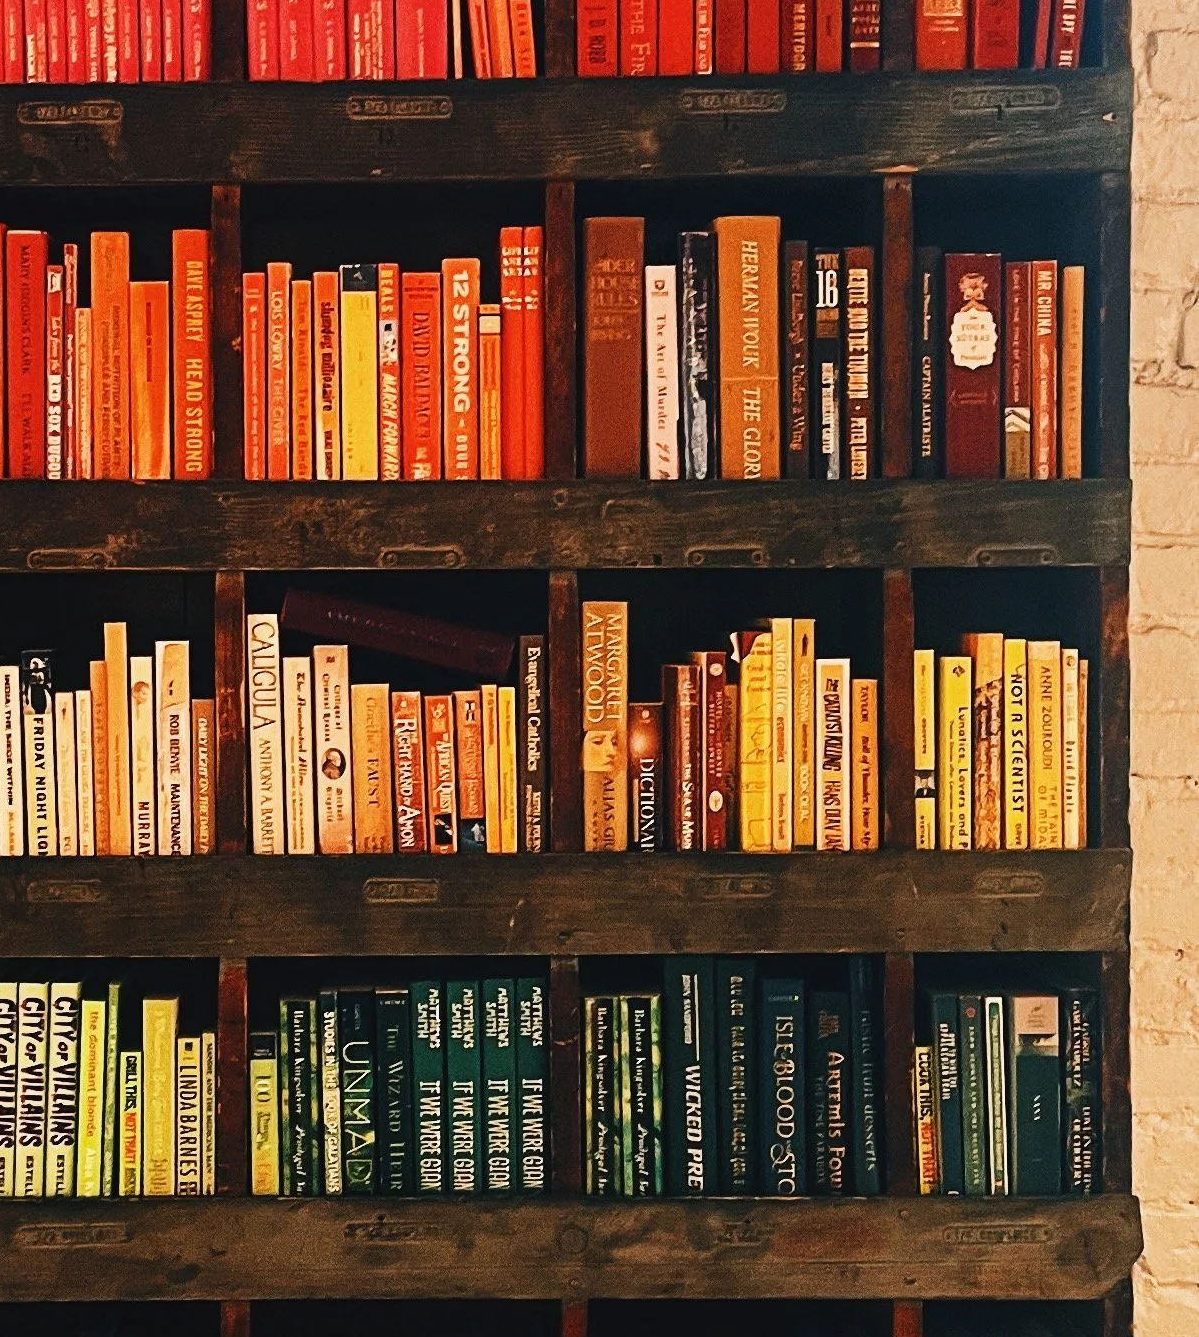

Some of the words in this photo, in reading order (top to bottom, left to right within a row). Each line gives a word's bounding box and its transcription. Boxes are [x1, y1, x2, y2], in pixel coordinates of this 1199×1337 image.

[631, 0, 644, 34] THE
[186, 261, 203, 293] DAVE
[380, 269, 394, 313] BEALS
[454, 270, 469, 297] 12
[742, 240, 759, 312] HERMAN
[1038, 271, 1051, 291] MR.
[186, 296, 203, 341] ASPREY
[272, 290, 283, 320] LOIS
[656, 314, 666, 337] The
[1038, 297, 1051, 336] CHINA
[271, 325, 283, 370] LOWRY
[454, 304, 470, 413] STRONG
[656, 343, 666, 361] Art
[743, 317, 759, 368] WOUK
[49, 375, 62, 402] RED
[186, 358, 202, 402] HEAD
[273, 378, 283, 402] THE
[656, 368, 666, 380] of
[922, 356, 931, 400] CAPTAIN
[382, 373, 396, 420] MARCH
[657, 386, 667, 430] Murder
[743, 387, 760, 421] THE
[49, 406, 62, 433] SOX
[185, 408, 203, 472] STRONG
[273, 406, 284, 446] GIVER
[922, 403, 931, 457] ALATRISTE
[383, 421, 397, 479] FORWARD
[252, 622, 276, 731] CALIGULA
[525, 647, 540, 714] Evangelical
[585, 612, 604, 723] ATWOOD
[606, 613, 624, 722] MARGARET
[1041, 666, 1052, 702] ANNE
[1011, 674, 1022, 706] NOT
[394, 718, 418, 759] RIGHT
[1012, 713, 1023, 722] A
[1042, 706, 1053, 770] ZOUROUDI
[34, 717, 45, 769] FRIDAY
[526, 717, 540, 771] Catholics
[258, 738, 272, 792] ANTHONY
[398, 762, 411, 795] HAND
[1012, 730, 1024, 812] SCIENTIST
[35, 777, 46, 819] NIGHT
[260, 796, 273, 805] A.
[958, 769, 968, 808] Lovers
[260, 808, 274, 855] BARRETT
[398, 805, 420, 847] AMON
[959, 814, 967, 836] and
[52, 997, 78, 1042] CITY
[485, 1002, 496, 1036] SMITH
[497, 987, 508, 1047] MATTHEWS
[520, 1001, 530, 1036] SMITH
[532, 986, 542, 1046] MATTHEWS
[49, 1063, 76, 1146] VILLAINS
[179, 1066, 197, 1111] LINDA
[488, 1079, 509, 1093] IF
[488, 1095, 509, 1115] WE
[522, 1079, 543, 1091] IF
[522, 1094, 543, 1114] WE
[685, 1065, 702, 1141] WICKED
[773, 1060, 795, 1138] BLOOD
[827, 1052, 845, 1138] ARTEMIS
[180, 1114, 197, 1177] BARNES
[489, 1119, 509, 1153] WERE
[523, 1118, 543, 1152] WERE
